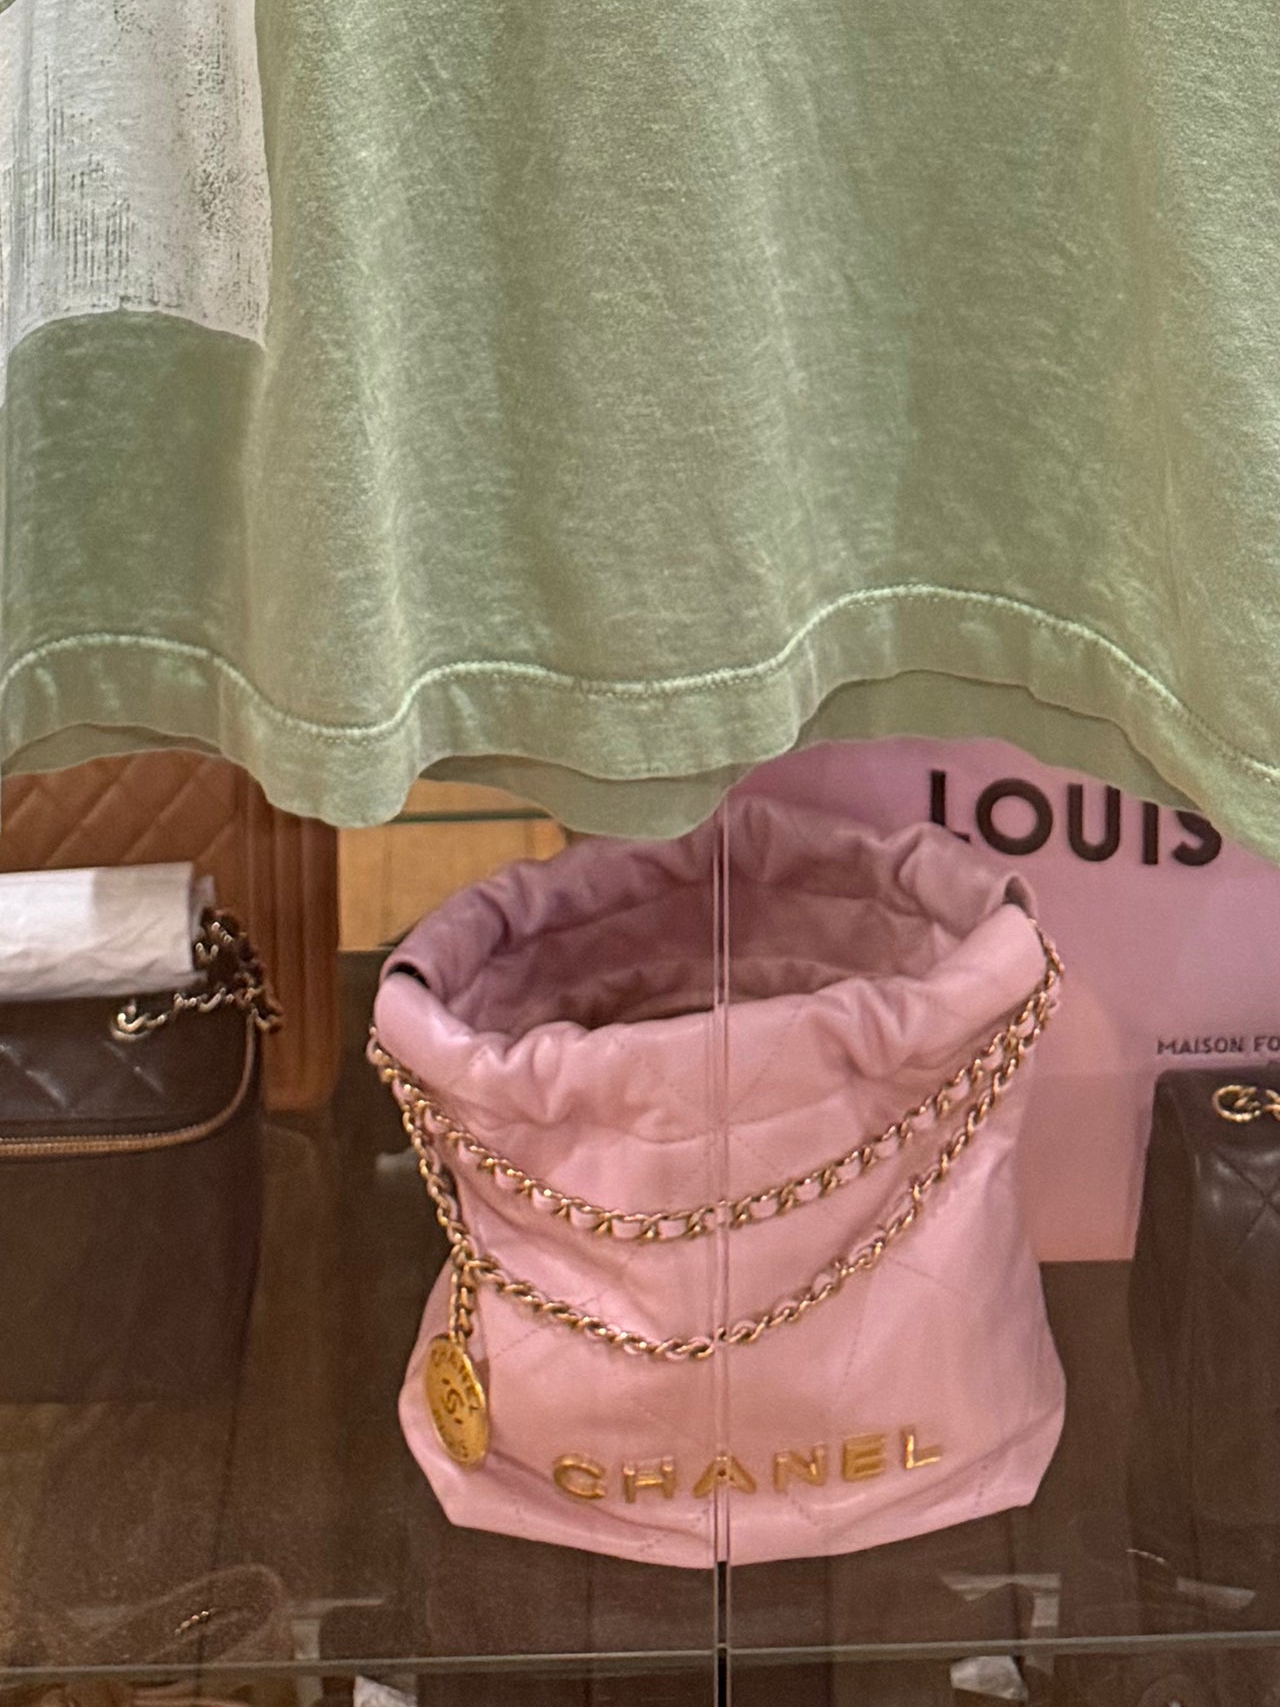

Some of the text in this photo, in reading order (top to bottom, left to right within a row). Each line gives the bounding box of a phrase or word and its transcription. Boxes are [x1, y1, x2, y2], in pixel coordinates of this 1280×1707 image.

[930, 769, 1223, 868] LOUIS
[1156, 1037, 1244, 1055] MAISON
[552, 1424, 941, 1505] CHANEL
